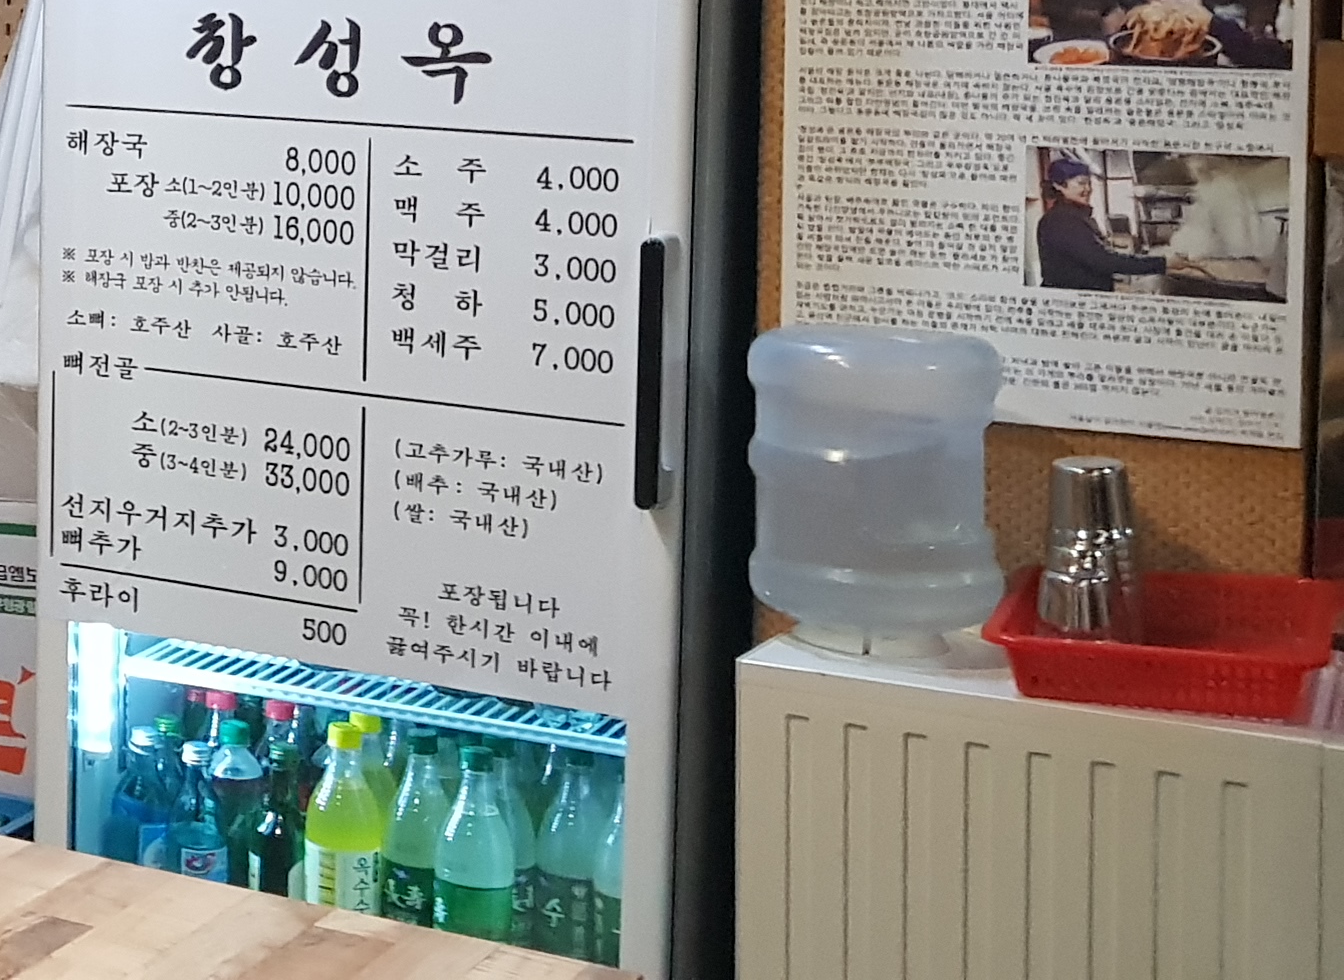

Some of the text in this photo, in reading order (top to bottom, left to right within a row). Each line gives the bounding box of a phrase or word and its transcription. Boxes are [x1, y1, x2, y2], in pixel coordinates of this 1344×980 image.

[66, 128, 356, 177] 해장국 8,000
[106, 171, 160, 198] 포장
[273, 180, 355, 211] 10,000
[273, 214, 355, 246] 16,000
[84, 248, 115, 267] 포장
[119, 250, 134, 269] 시
[140, 252, 171, 271] 밥과
[175, 255, 222, 277] 반찬은
[290, 266, 357, 290] 않습니다.
[392, 238, 481, 274] 막걸리
[85, 269, 288, 307] 해장국 포장 시 추가 안됩니다.
[129, 315, 192, 340] 호주산
[276, 331, 343, 356] 호주산
[391, 326, 482, 361] 백세주
[263, 427, 351, 462] 24,000
[265, 461, 350, 497] 33,000
[521, 455, 603, 485] 국내산)
[476, 481, 557, 512] 국내산)
[61, 493, 258, 545] 선지우거지추가
[449, 509, 529, 540] 국내산)
[59, 577, 347, 646] 후라이 500
[438, 581, 561, 619] 포장됩니다
[397, 606, 599, 658] 꼭! 한시간 이내에
[386, 635, 613, 692] 끓여주시기 바랍니다
